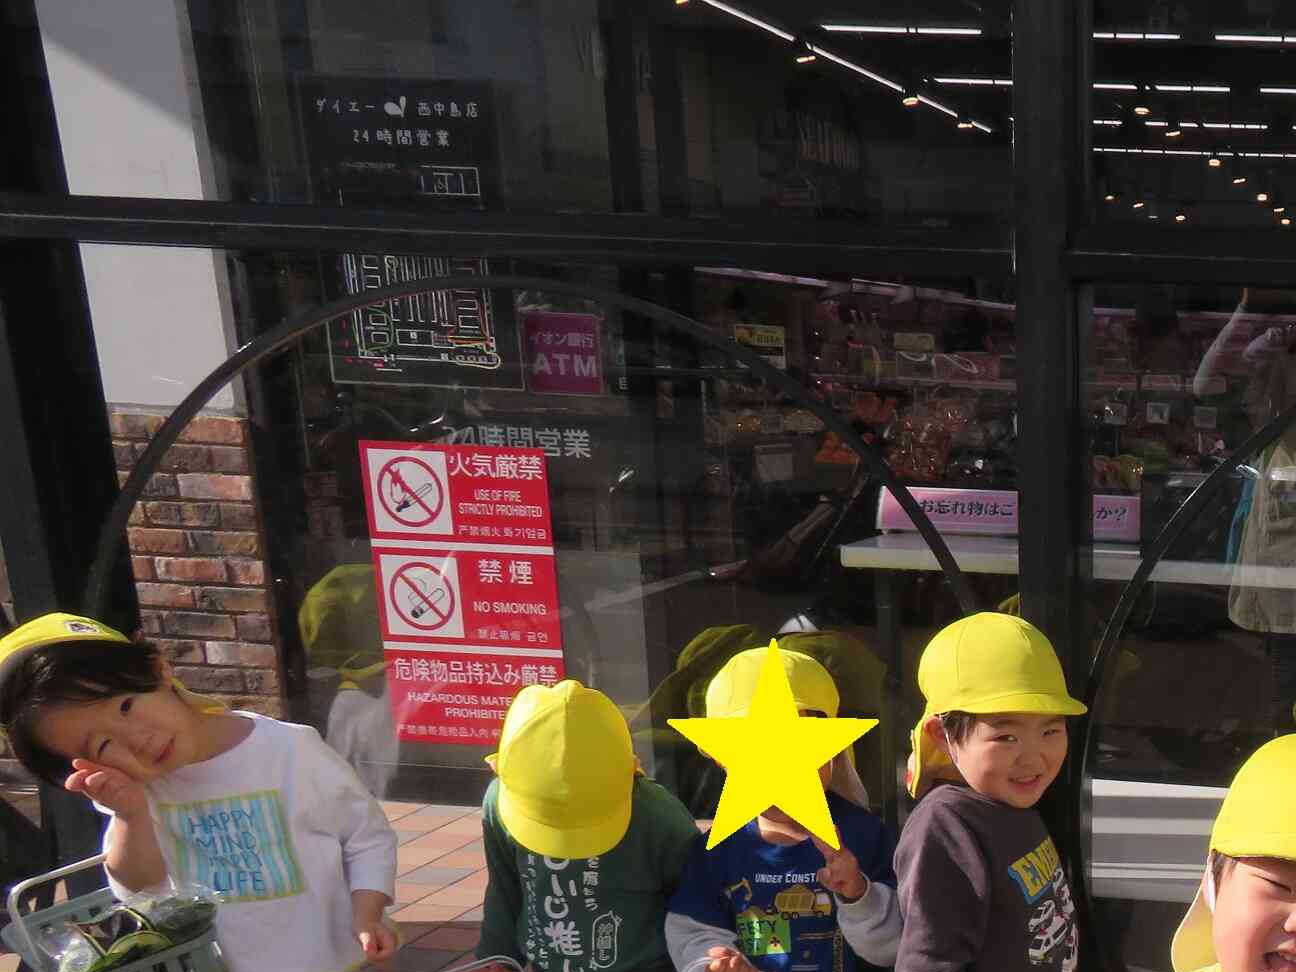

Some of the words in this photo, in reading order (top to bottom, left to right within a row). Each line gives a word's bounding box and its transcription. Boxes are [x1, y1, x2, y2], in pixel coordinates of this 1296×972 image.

[533, 353, 598, 377] ATM
[449, 453, 544, 481] 火気厳禁
[458, 502, 495, 515] STRICTLY
[495, 504, 543, 518] PROHIBITED
[473, 601, 491, 612] NO
[493, 602, 547, 616] SMOKING
[394, 658, 558, 686] 危険物品持込み厳禁
[407, 691, 478, 706] HAZARDOUS
[484, 694, 513, 706] MATE
[444, 707, 505, 720] PROHIBITE
[188, 808, 255, 834] HAPPY
[195, 831, 257, 854] MIND
[213, 870, 266, 892] LIFE
[754, 872, 784, 884] UNDER
[785, 872, 818, 884] CONST
